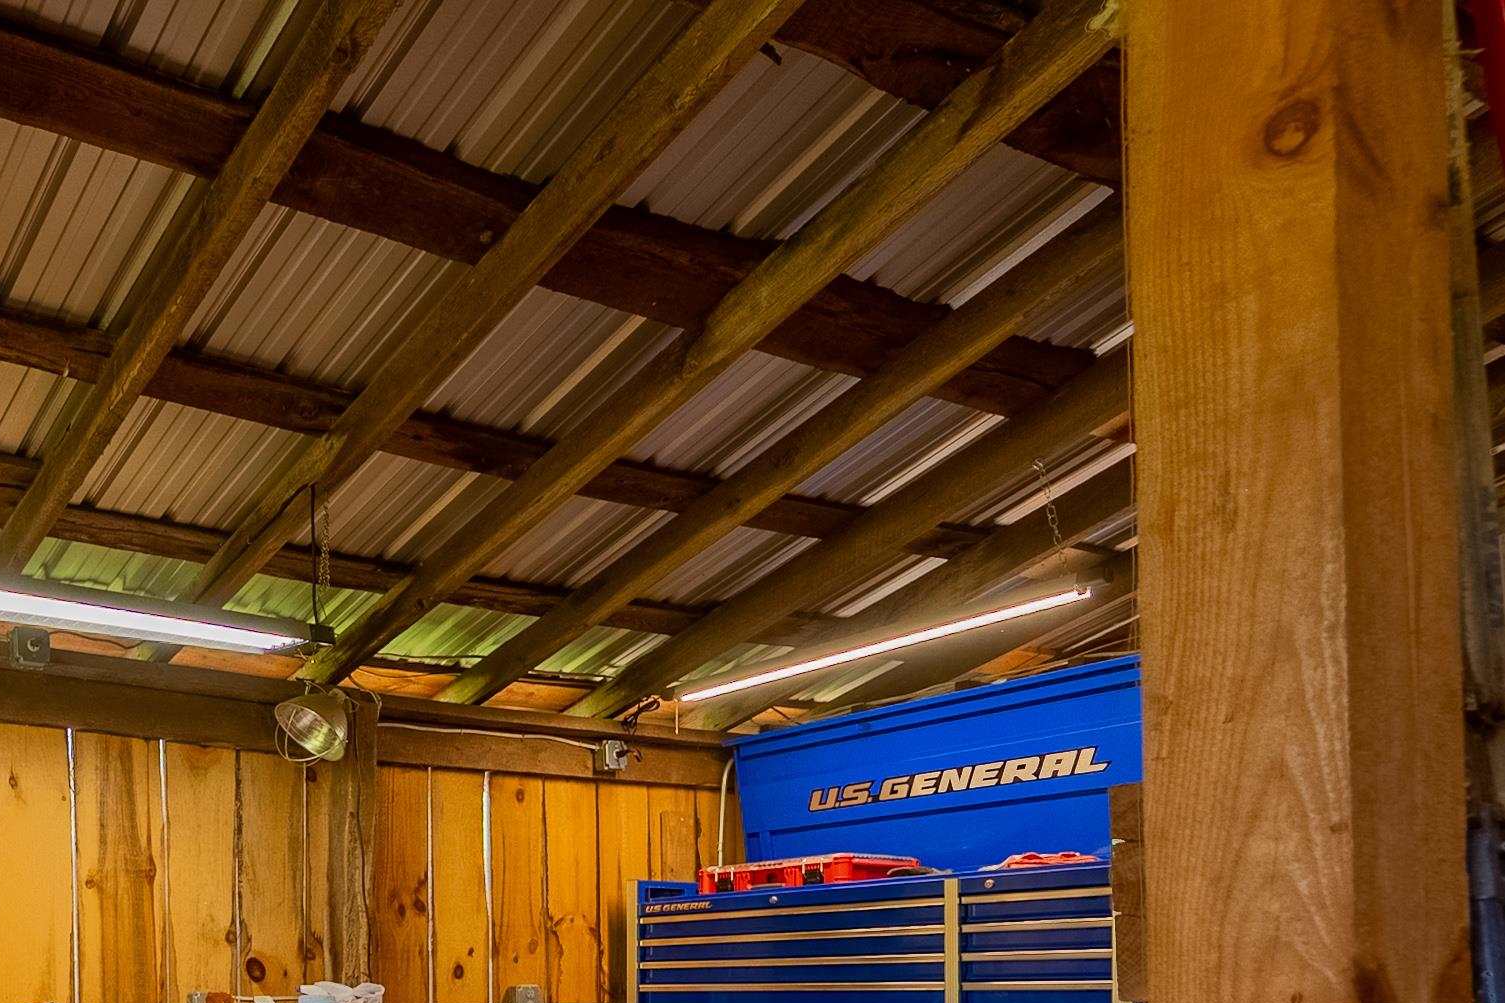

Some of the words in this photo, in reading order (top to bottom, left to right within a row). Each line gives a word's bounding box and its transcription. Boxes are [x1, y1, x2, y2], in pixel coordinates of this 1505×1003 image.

[808, 780, 874, 812] U.S.
[879, 746, 1112, 802] GENERAL
[662, 901, 713, 912] GENERAL
